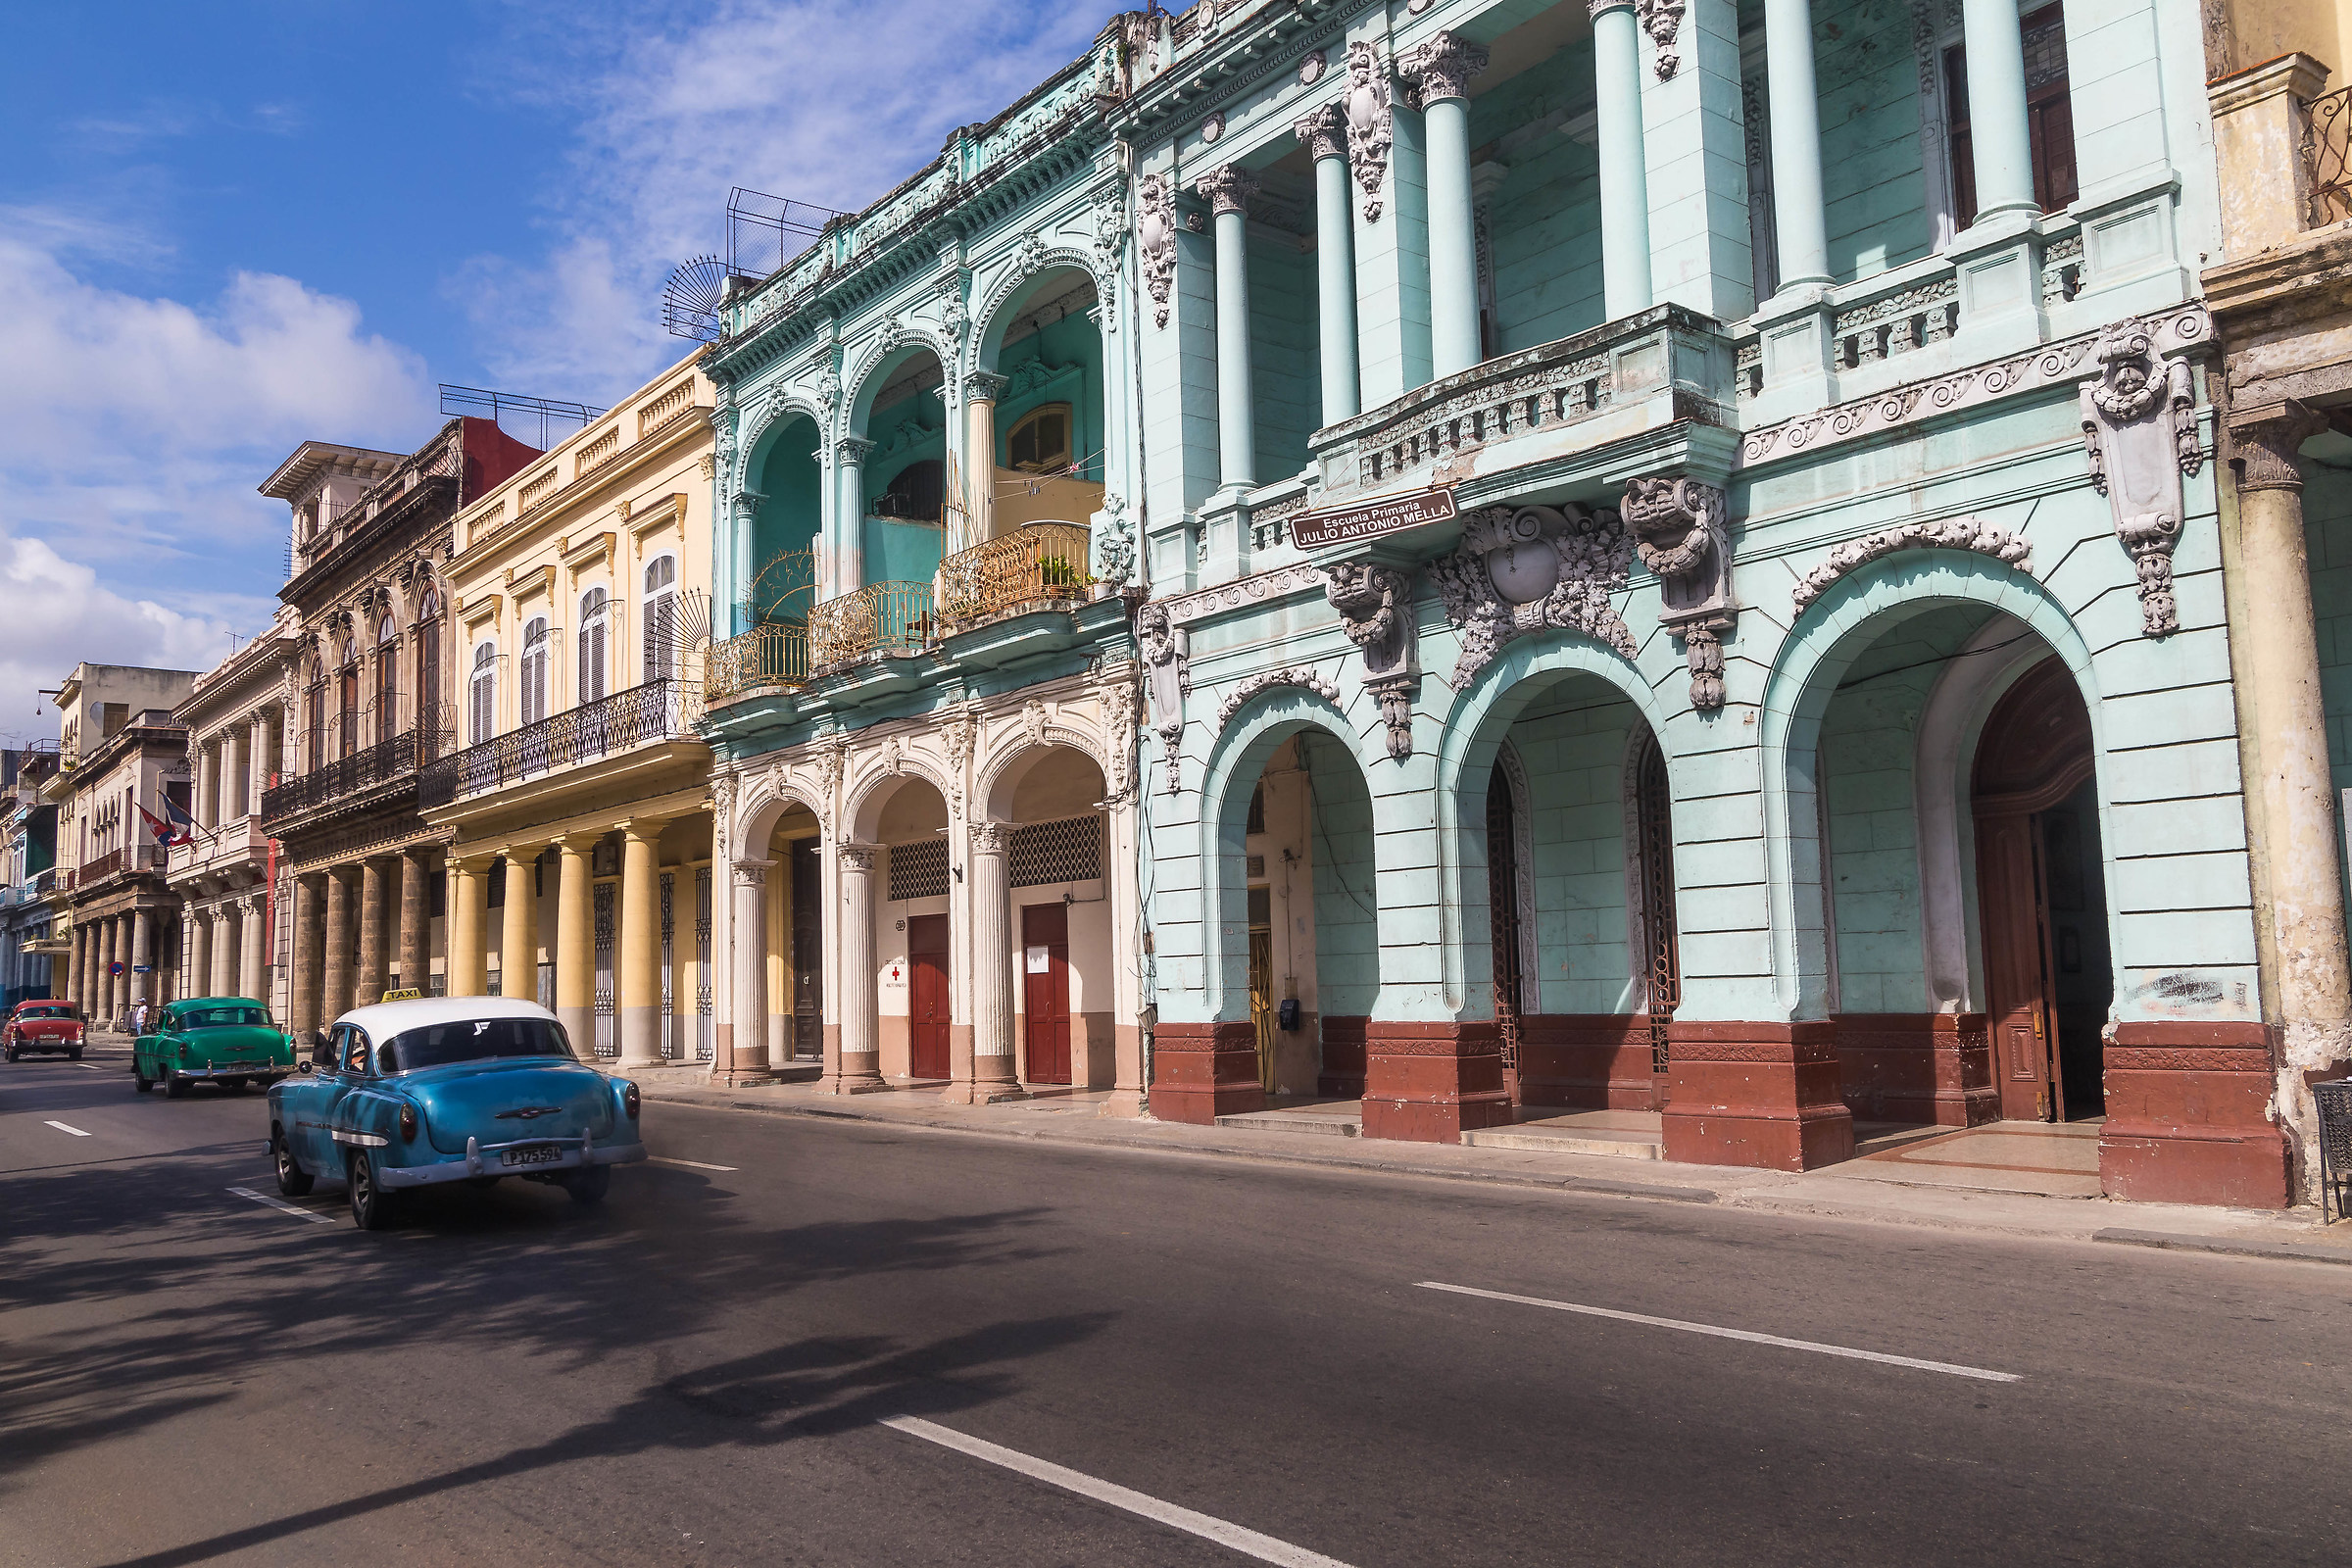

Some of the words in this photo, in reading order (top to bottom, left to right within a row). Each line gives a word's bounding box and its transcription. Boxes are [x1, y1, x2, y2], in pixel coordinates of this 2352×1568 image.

[1299, 527, 1339, 544] JULIO
[1342, 515, 1401, 537] ANTONIO
[1403, 505, 1450, 524] MELLA
[1323, 514, 1369, 529] Escuela
[1371, 501, 1421, 520] Primaria
[388, 989, 417, 1000] TAXI
